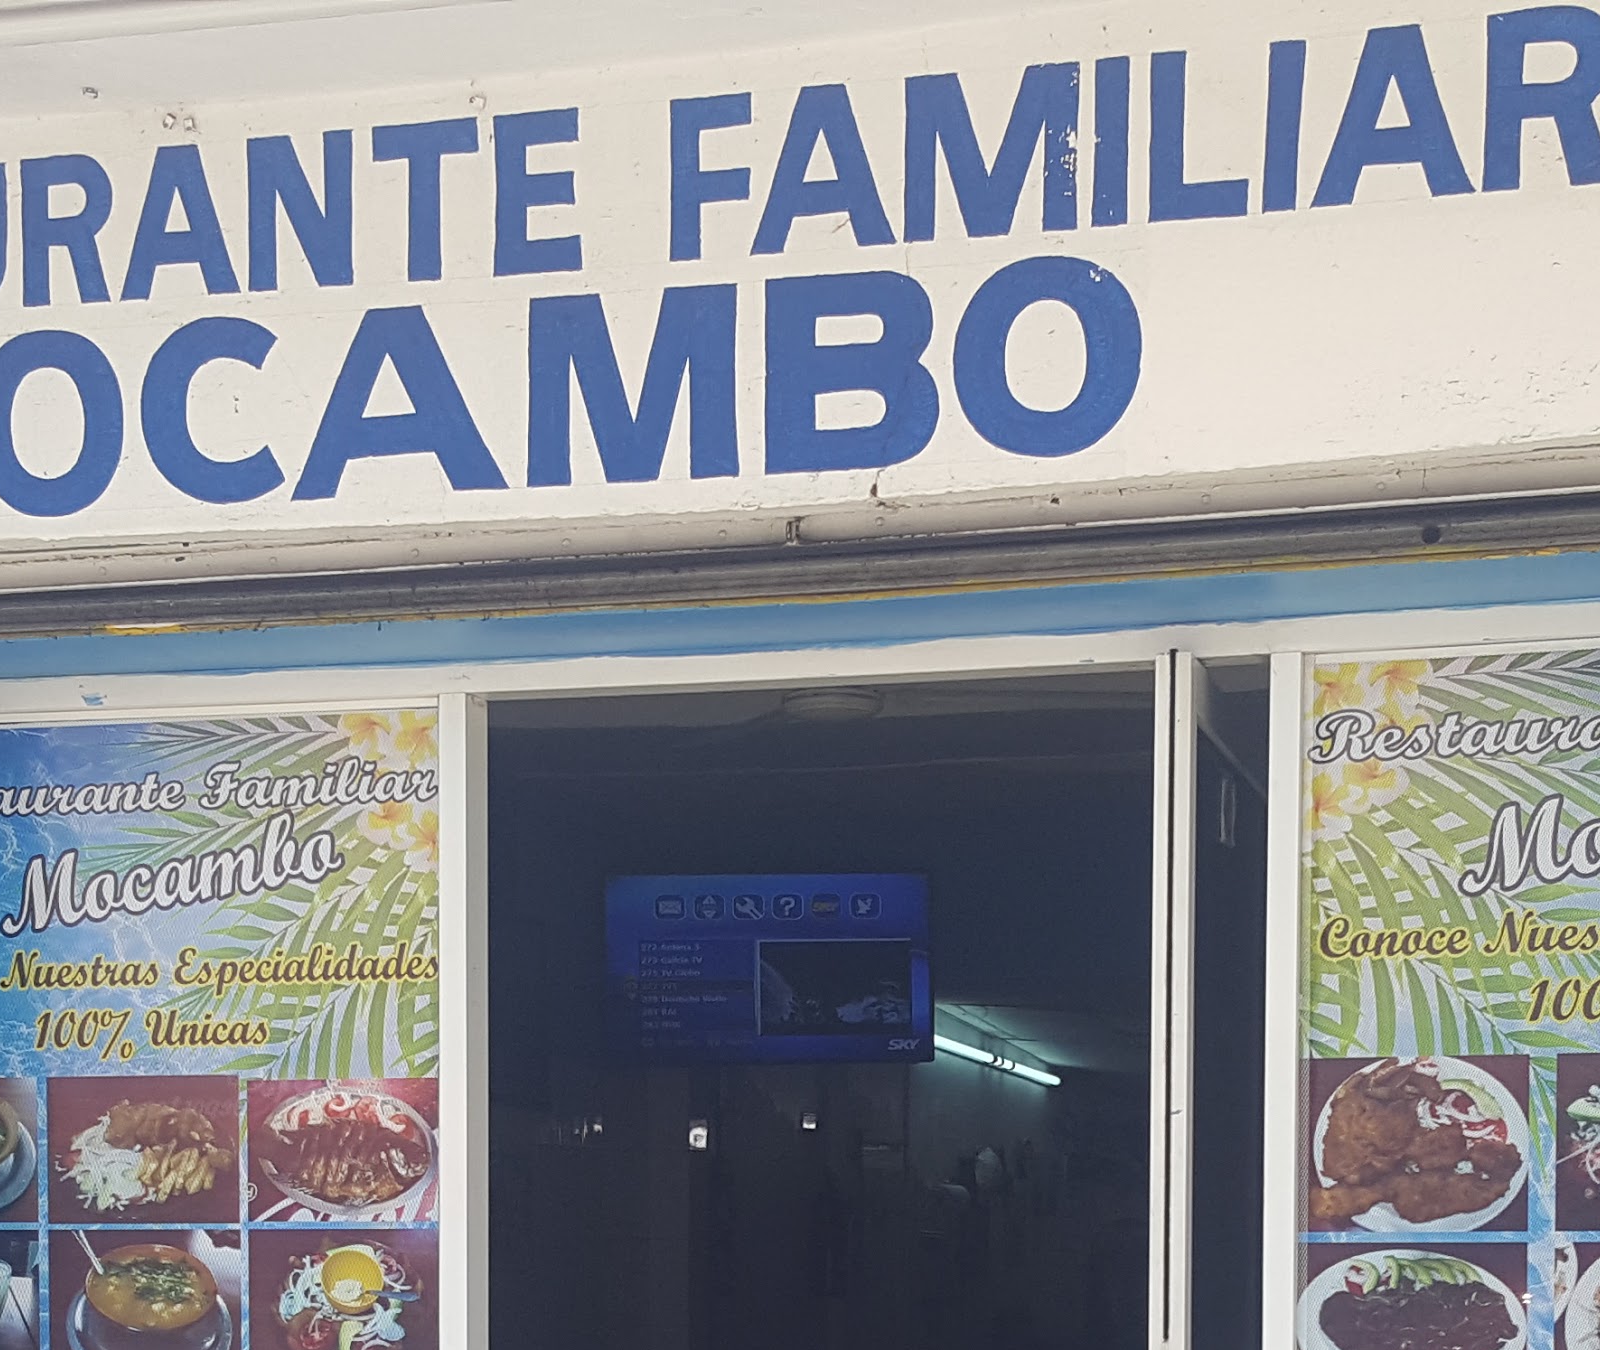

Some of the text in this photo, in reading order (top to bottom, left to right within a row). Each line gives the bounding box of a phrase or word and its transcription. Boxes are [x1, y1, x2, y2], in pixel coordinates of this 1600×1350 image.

[200, 756, 439, 811] Familiar
[1, 812, 344, 936] Mocambo
[1315, 916, 1471, 960] Conoce
[0, 948, 160, 991] Nuestras
[174, 942, 439, 997] Especialidades
[35, 1006, 269, 1061] 100% Unicas
[888, 1039, 920, 1051] SKY
